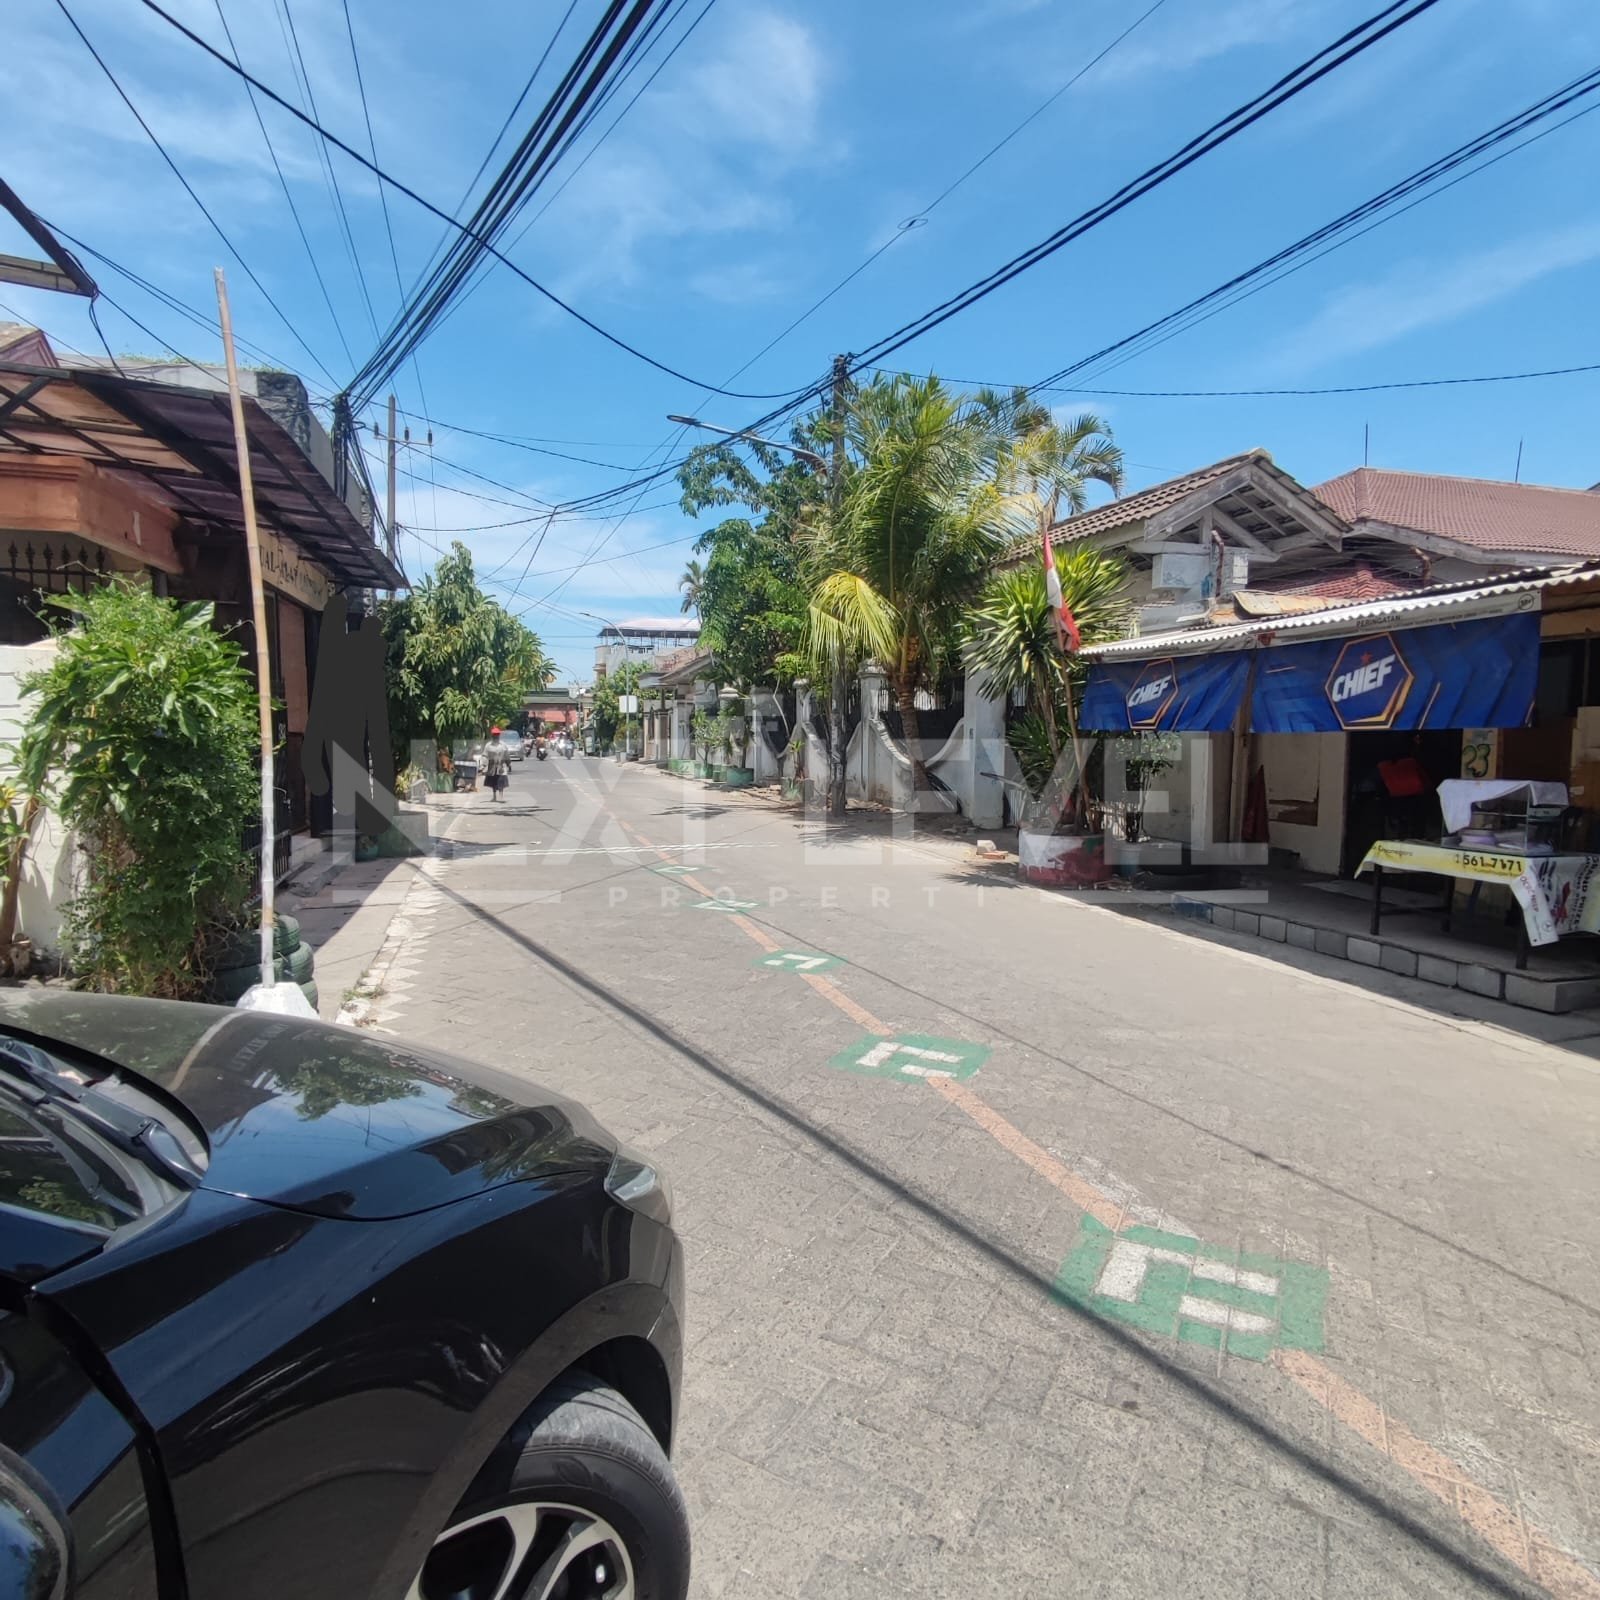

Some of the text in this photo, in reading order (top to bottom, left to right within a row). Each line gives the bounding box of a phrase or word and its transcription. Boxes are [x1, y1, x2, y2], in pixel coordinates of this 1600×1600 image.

[1356, 614, 1401, 628] PERINGATAN
[1128, 674, 1172, 708] CHIEF
[1332, 654, 1396, 703] CHIEF
[1463, 744, 1491, 778] 23
